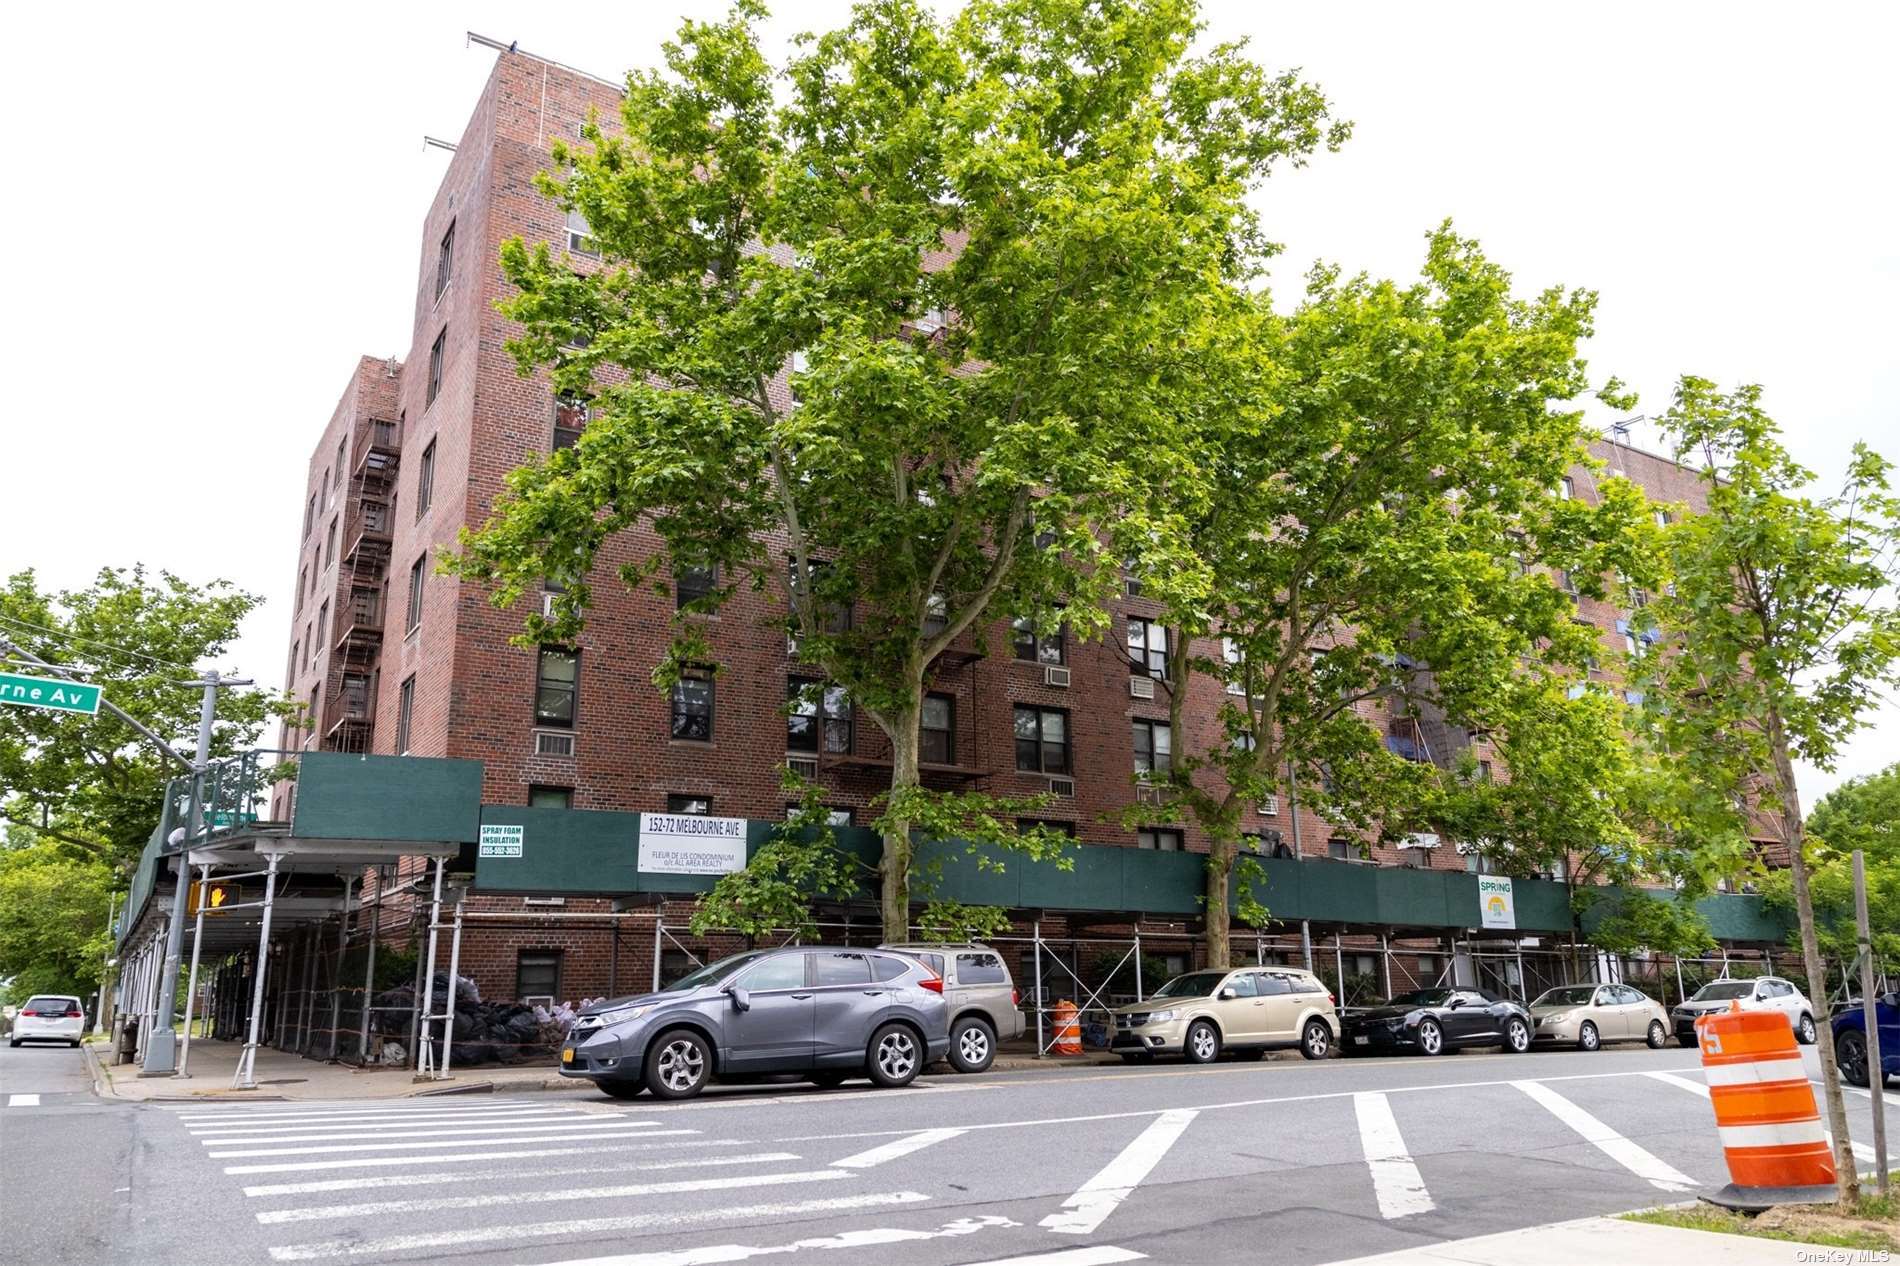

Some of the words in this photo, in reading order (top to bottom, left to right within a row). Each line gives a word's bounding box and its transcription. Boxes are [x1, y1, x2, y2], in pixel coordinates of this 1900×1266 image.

[0, 684, 42, 699] rne
[49, 688, 82, 704] Av
[649, 817, 675, 832] 152-72
[676, 819, 723, 835] MELBOURNE
[725, 822, 739, 836] AVE
[482, 836, 520, 844] INSULATION
[652, 851, 670, 859] FLEUR
[671, 851, 680, 860] DE
[689, 853, 735, 861] CONDOMINIUM
[702, 860, 722, 868] REALTY
[1480, 881, 1511, 893] SPRING
